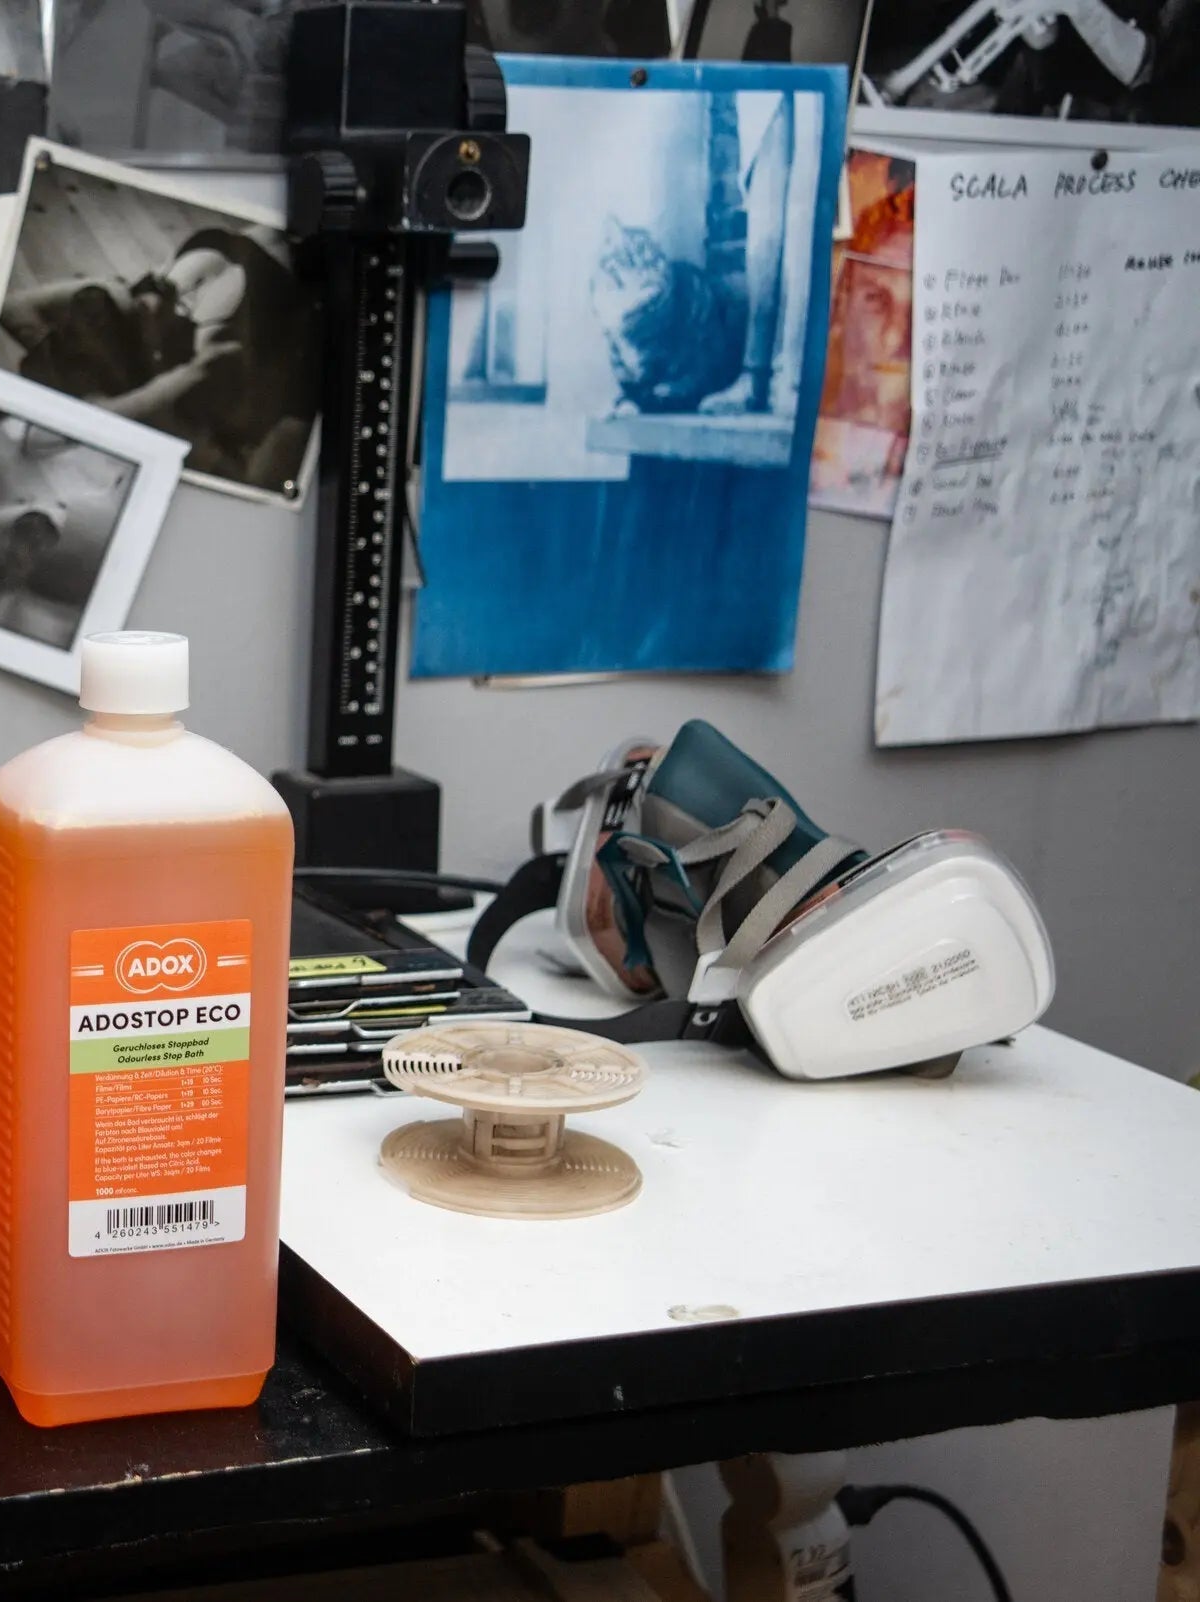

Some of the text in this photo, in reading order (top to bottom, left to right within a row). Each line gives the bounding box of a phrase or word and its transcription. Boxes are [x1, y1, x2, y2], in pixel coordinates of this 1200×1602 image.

[949, 172, 1028, 201] SCALA
[1054, 169, 1136, 198] PROCESS
[128, 954, 194, 977] ADOX
[78, 1004, 241, 1033] ADOSTOP ECO
[113, 1038, 209, 1053] Geruchloses Stoppbad
[117, 1049, 204, 1064] Odourless Stop Bath
[95, 1072, 133, 1083] Verdünnung
[140, 1069, 179, 1079] Zeit/Dilution
[96, 1083, 132, 1093] Filme/Films
[96, 1187, 114, 1196] 1000
[113, 1226, 157, 1238] 260243
[164, 1221, 208, 1233] 551479
